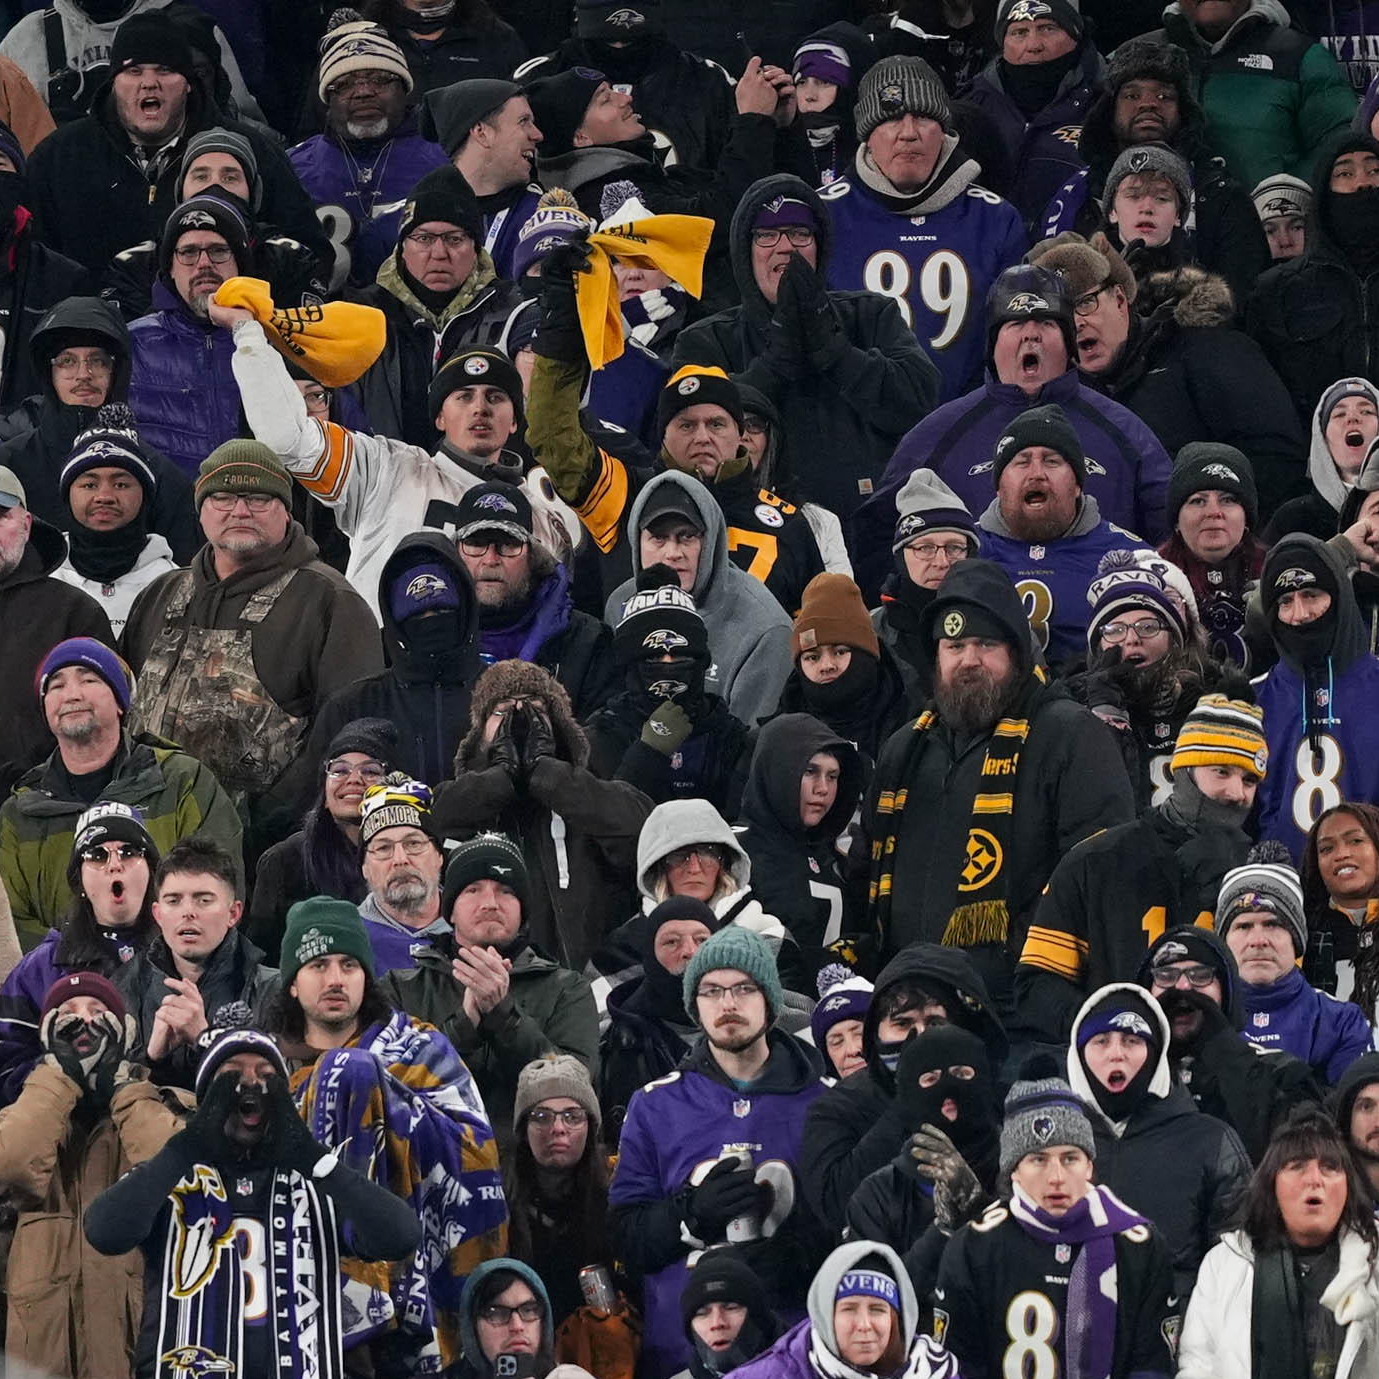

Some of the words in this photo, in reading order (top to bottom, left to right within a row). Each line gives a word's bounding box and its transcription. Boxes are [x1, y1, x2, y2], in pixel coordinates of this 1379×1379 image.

[863, 249, 970, 350] 89
[1292, 735, 1342, 835] 8
[273, 1172, 294, 1367] BALTIMORE
